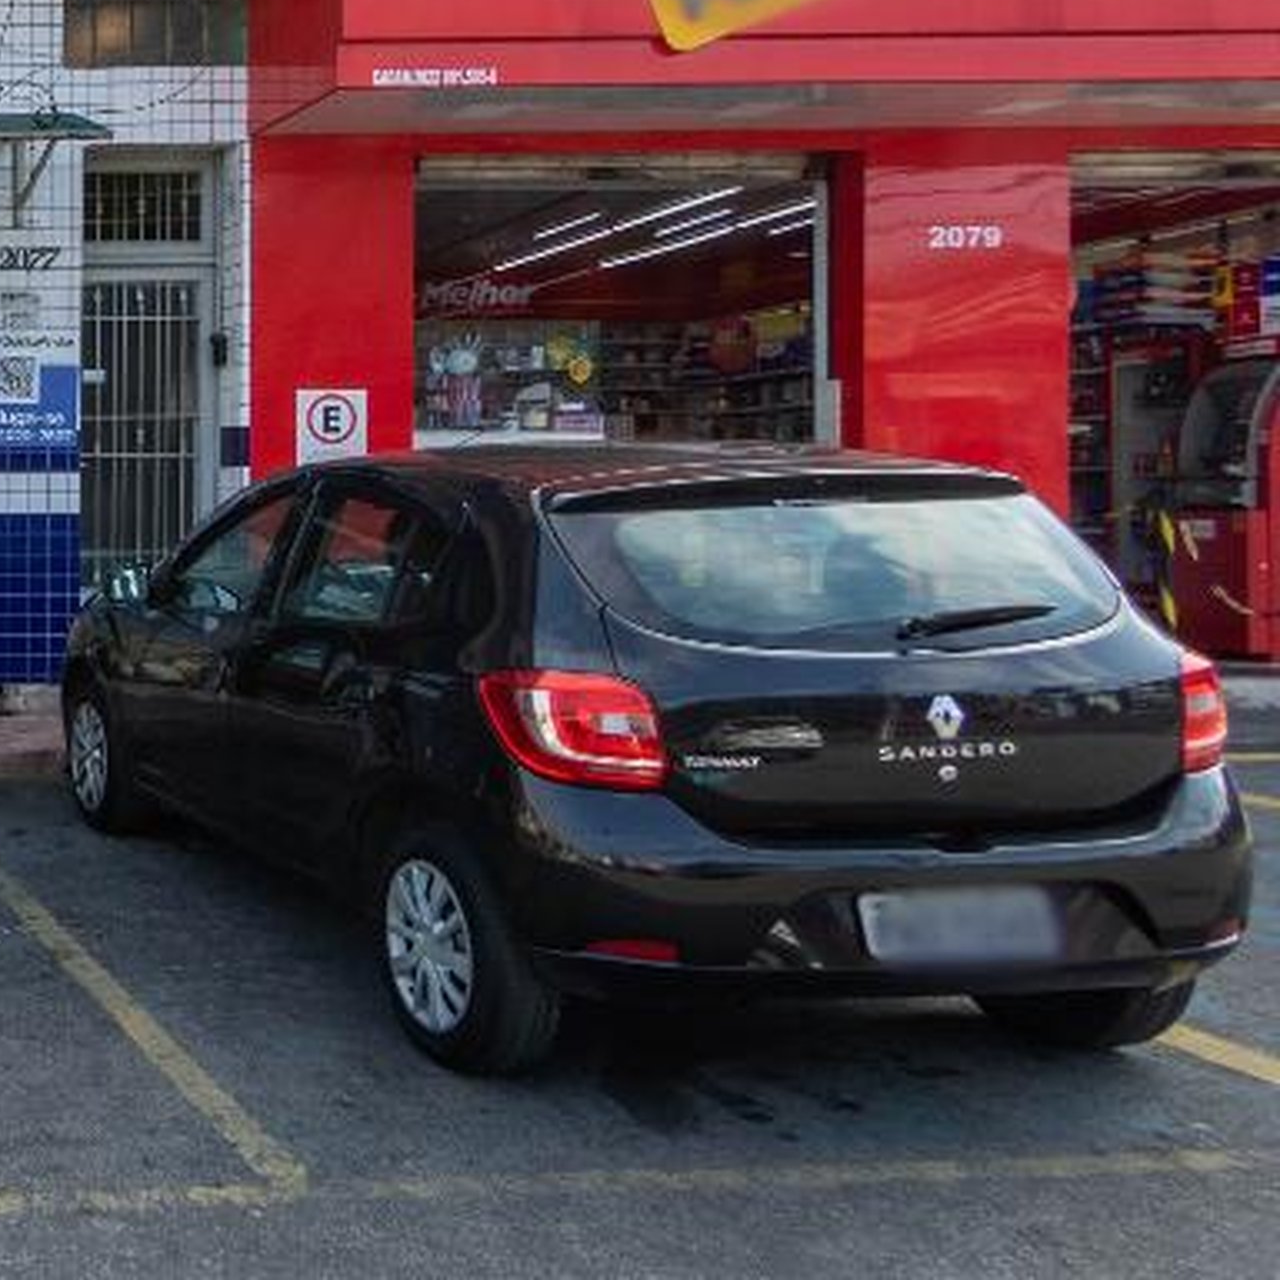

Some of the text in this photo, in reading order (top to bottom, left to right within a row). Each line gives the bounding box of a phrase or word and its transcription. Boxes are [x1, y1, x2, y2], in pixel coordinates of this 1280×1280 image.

[929, 225, 1002, 249] 2079
[0, 246, 61, 271] 2077
[424, 280, 534, 309] Melhor
[323, 406, 341, 433] E
[878, 740, 1017, 762] SANDERO
